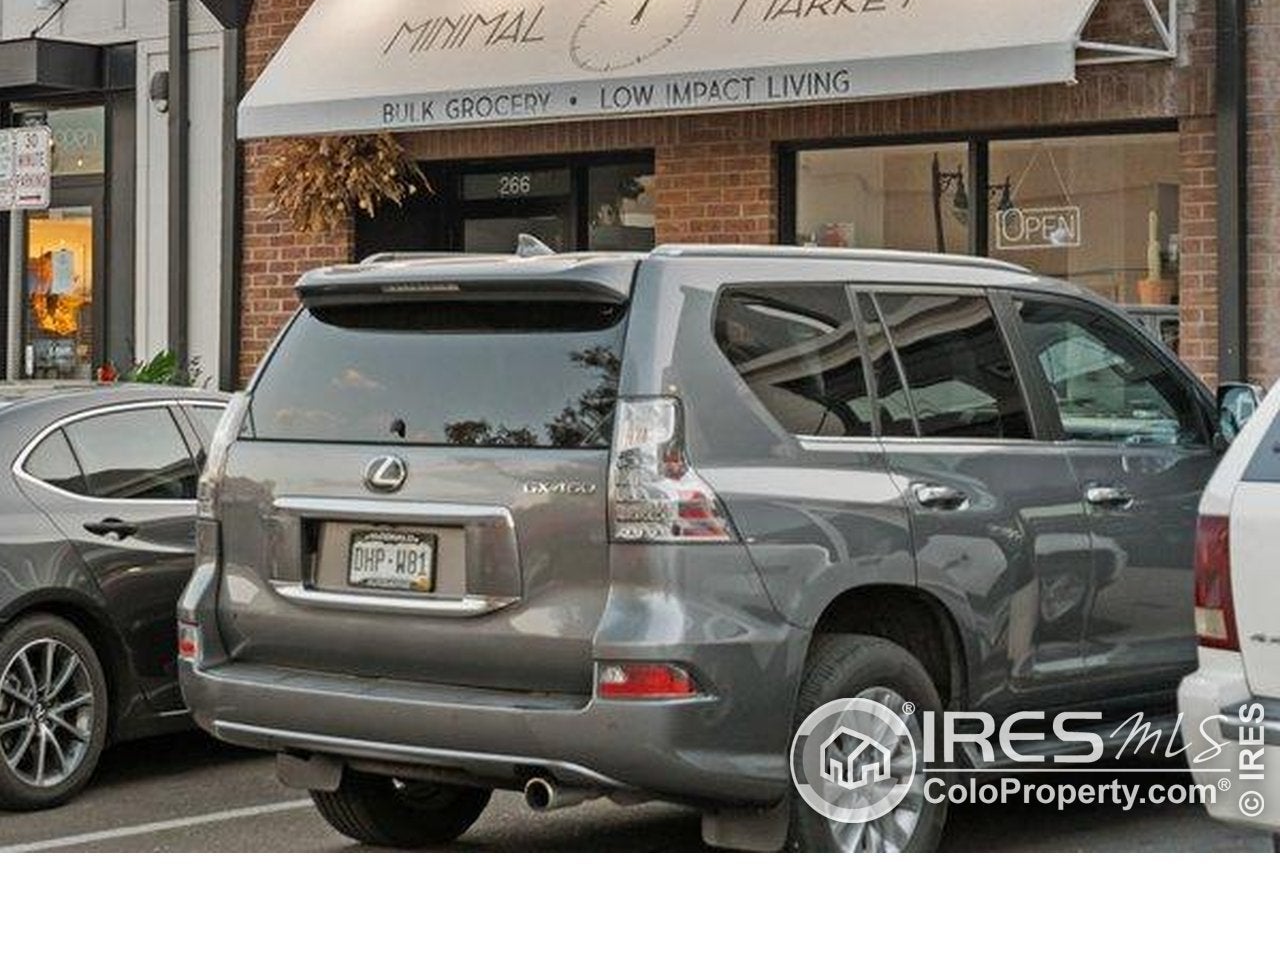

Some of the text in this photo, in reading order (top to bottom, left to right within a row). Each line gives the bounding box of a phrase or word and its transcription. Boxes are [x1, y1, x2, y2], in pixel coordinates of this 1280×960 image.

[383, 4, 545, 56] MINIMAL
[382, 69, 851, 125] BULK GROCERY LOW IMPACT LIVING
[500, 175, 531, 195] 266
